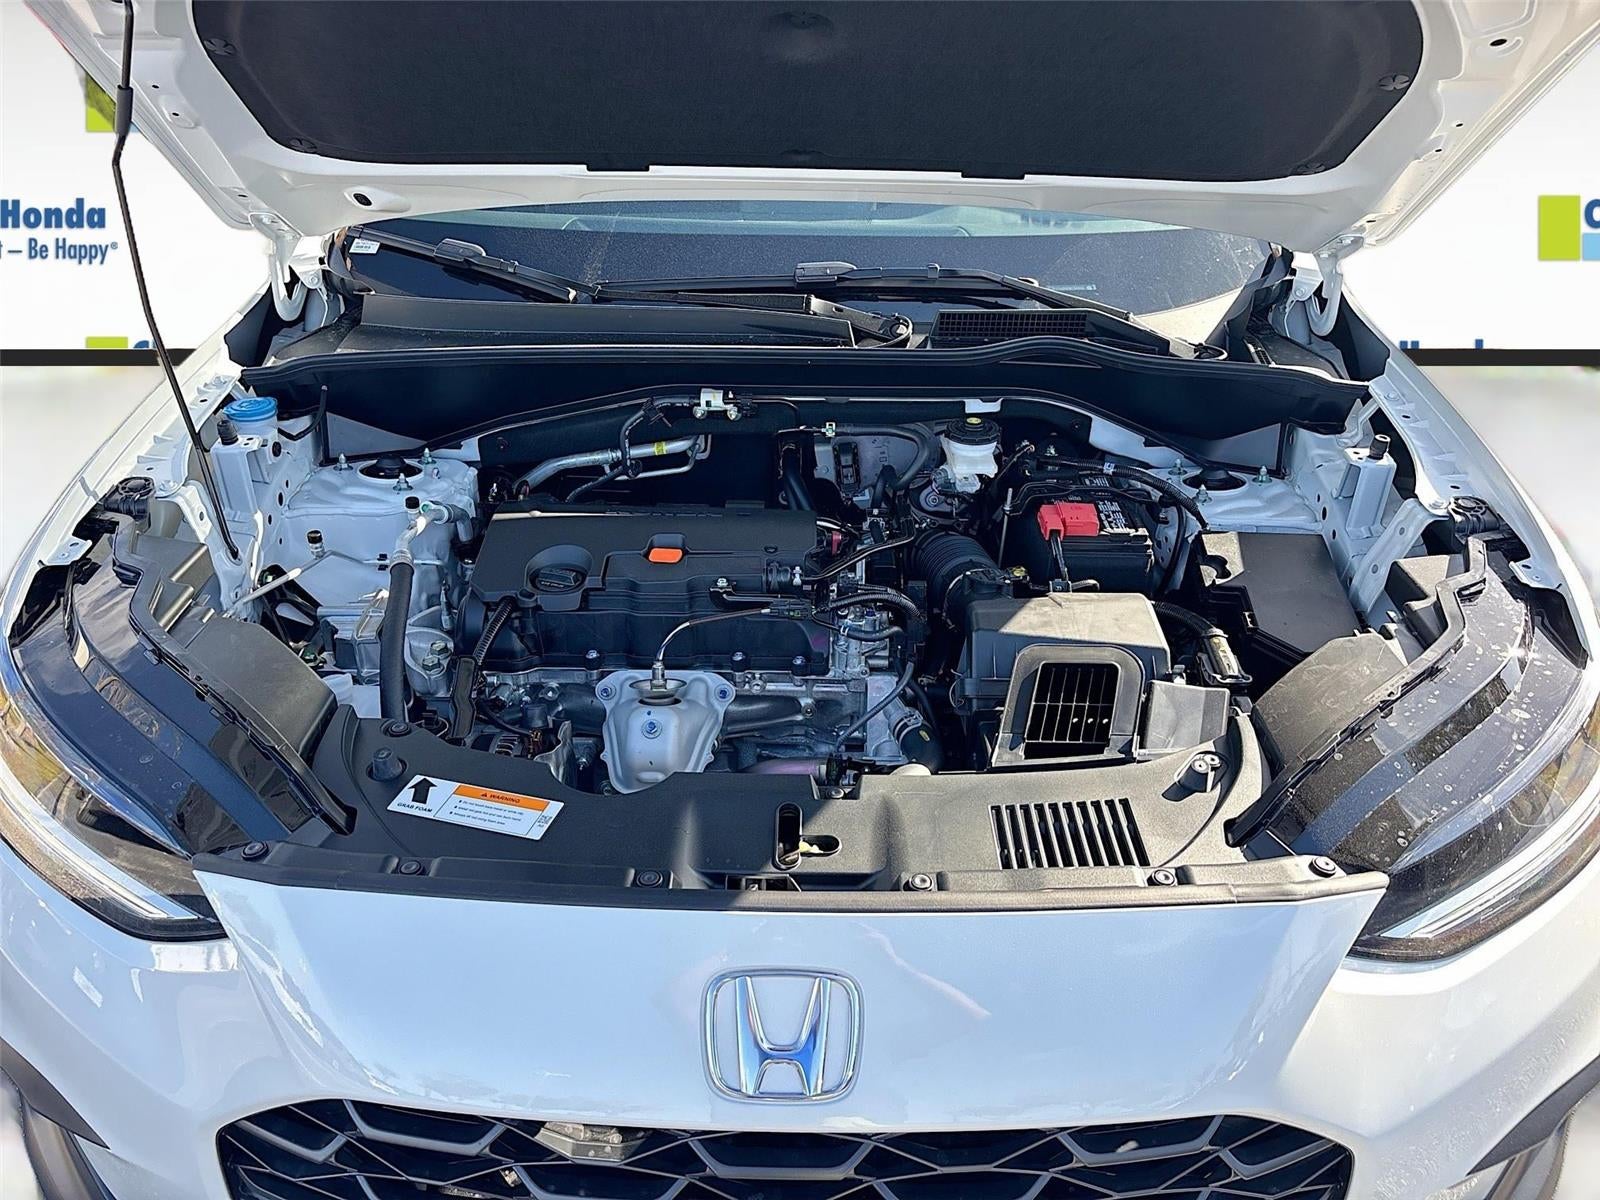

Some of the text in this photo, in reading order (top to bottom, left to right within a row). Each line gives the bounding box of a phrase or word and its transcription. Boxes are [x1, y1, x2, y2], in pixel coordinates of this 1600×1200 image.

[0, 197, 106, 229] Honda
[28, 237, 49, 260] Be
[490, 793, 520, 804] WARNING
[397, 802, 433, 813] GRAB FOAM
